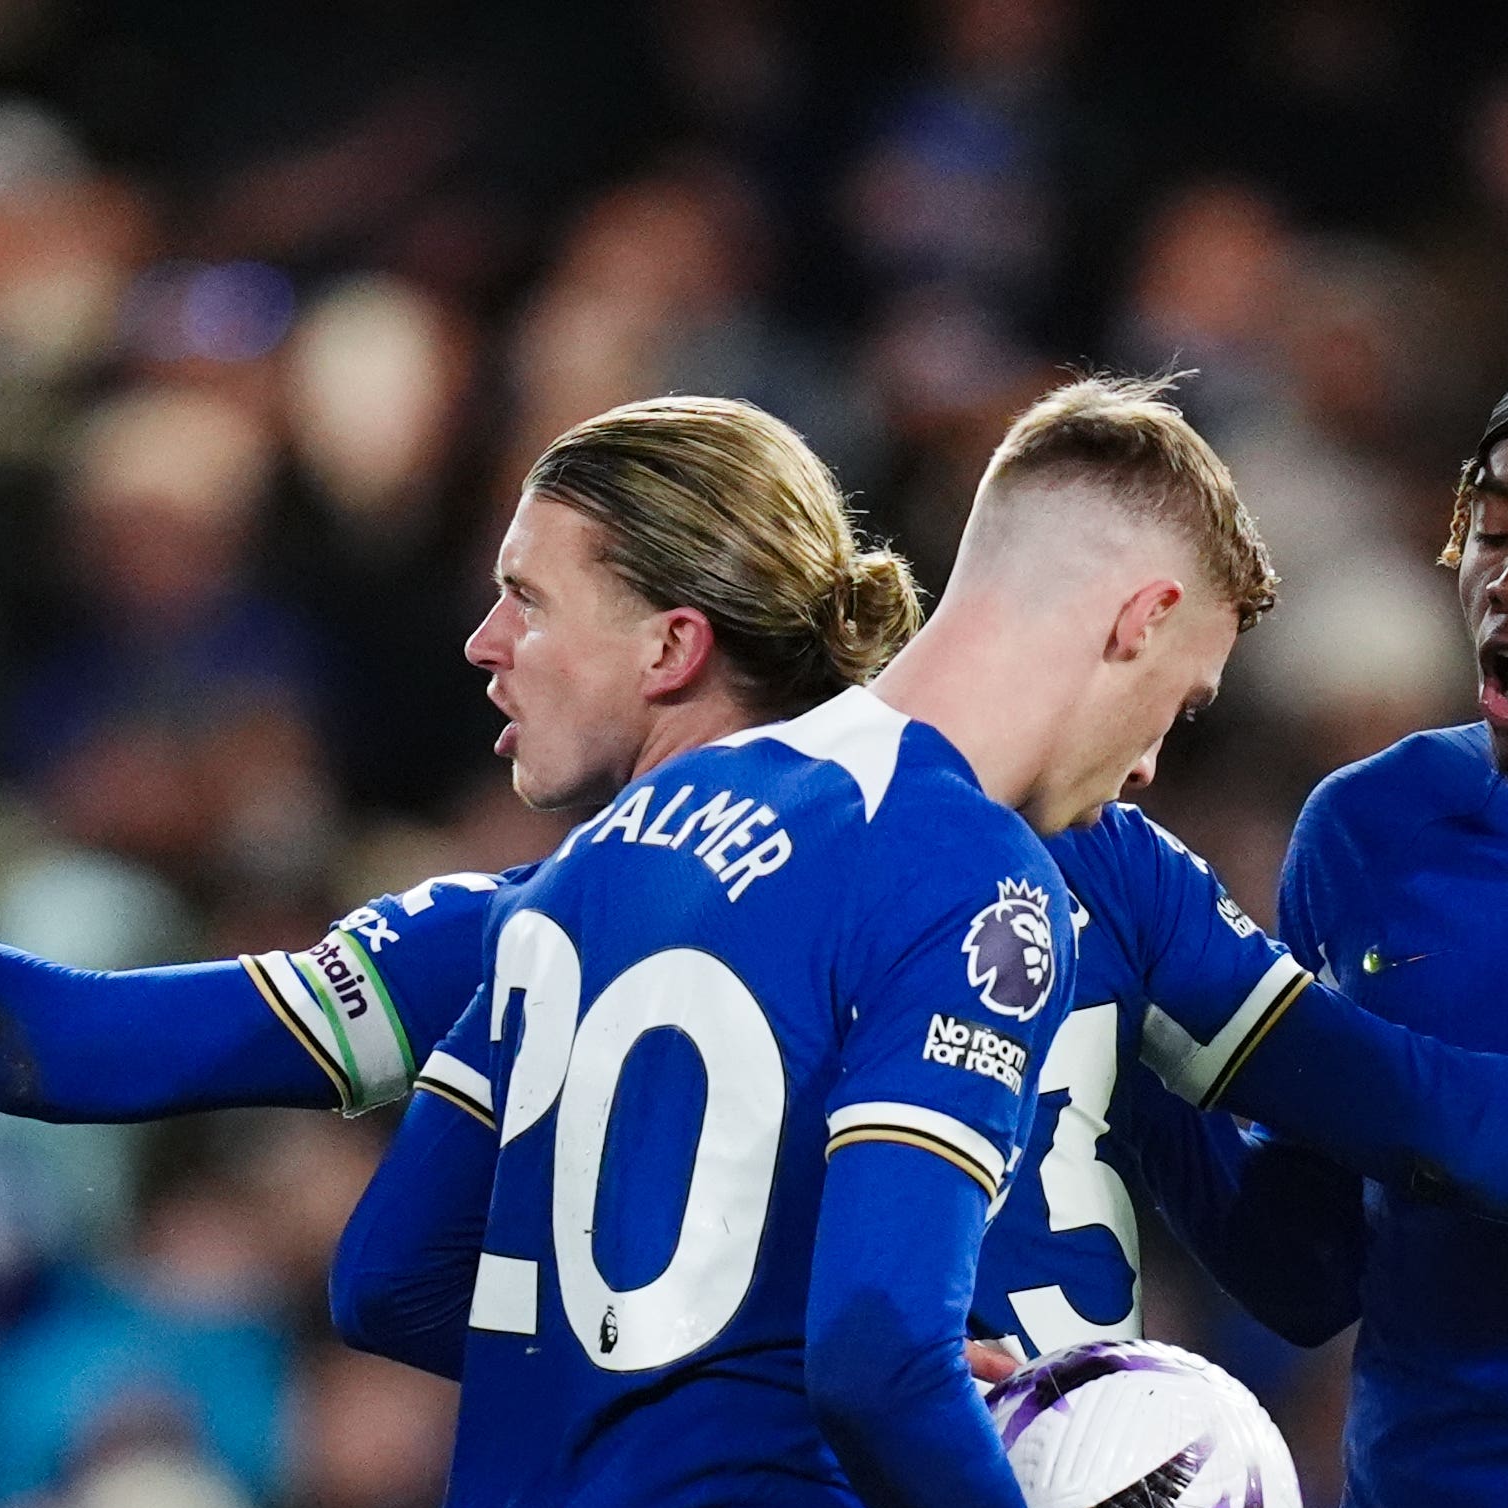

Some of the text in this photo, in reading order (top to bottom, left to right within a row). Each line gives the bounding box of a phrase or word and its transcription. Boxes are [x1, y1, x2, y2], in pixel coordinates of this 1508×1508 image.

[468, 908, 788, 1372] 20
[922, 1036, 966, 1067] for
[927, 1013, 1027, 1073] No room
[985, 1002, 1143, 1362] 3
